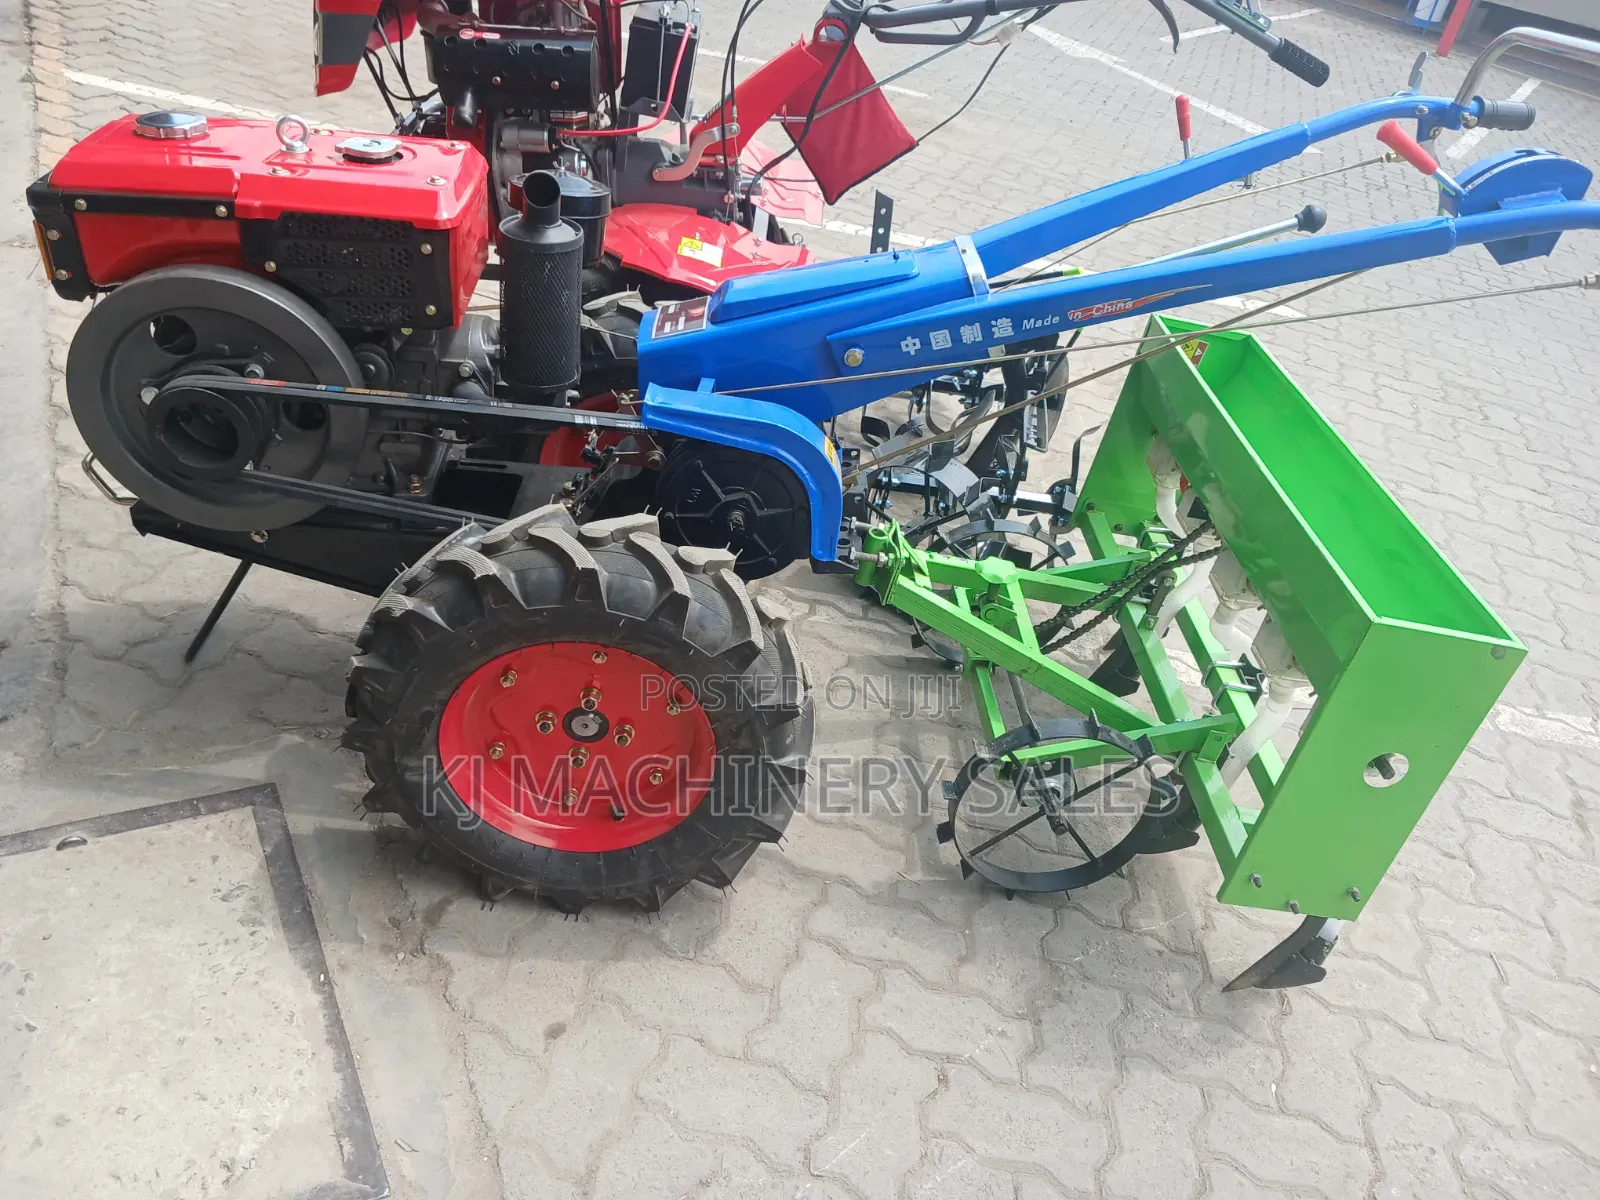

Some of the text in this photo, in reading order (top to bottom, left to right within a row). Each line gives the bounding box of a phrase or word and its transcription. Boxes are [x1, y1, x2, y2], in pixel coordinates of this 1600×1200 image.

[1022, 314, 1060, 331] Made
[1092, 301, 1133, 316] China
[900, 317, 1015, 356] 中国制造
